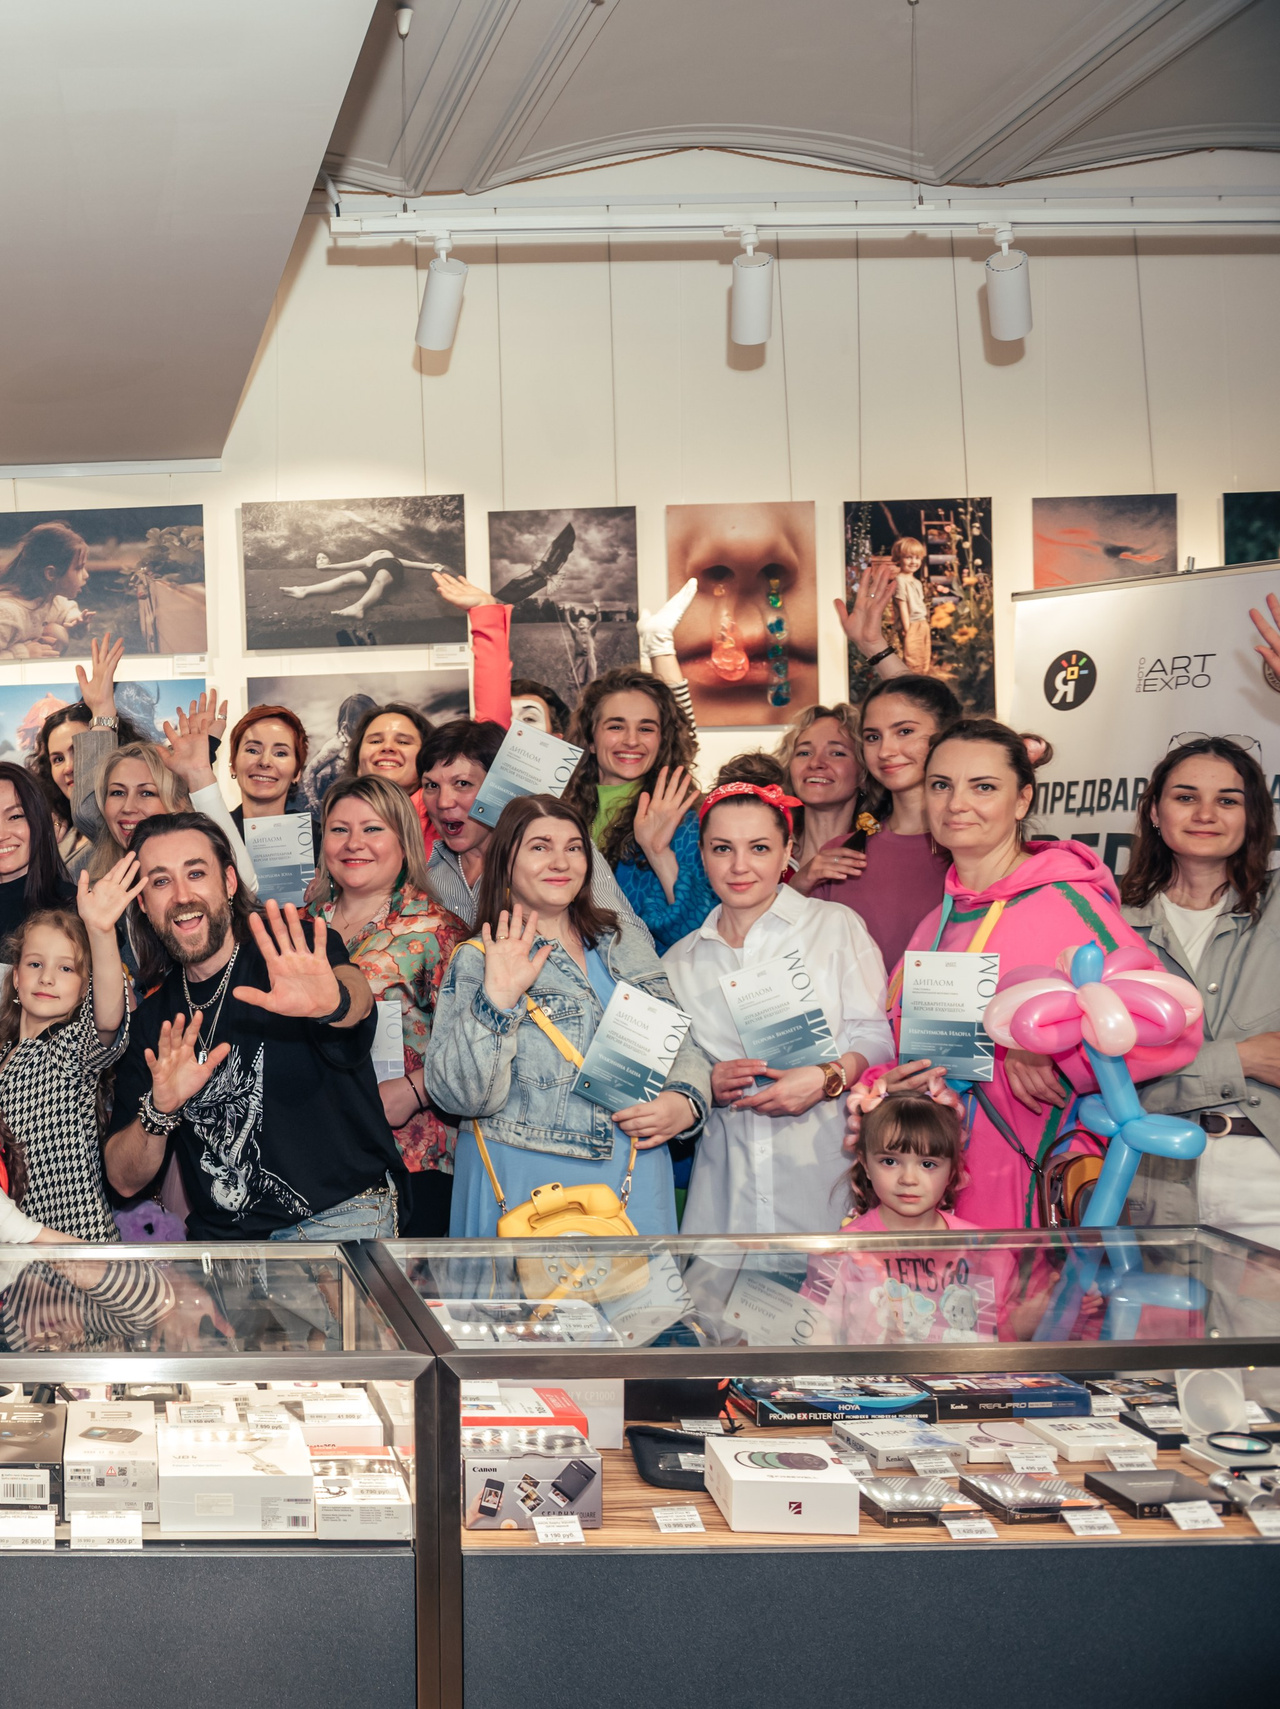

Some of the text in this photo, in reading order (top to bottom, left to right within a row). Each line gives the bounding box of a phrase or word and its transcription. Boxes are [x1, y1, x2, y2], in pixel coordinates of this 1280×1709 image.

[1145, 653, 1217, 677] ART
[1135, 657, 1146, 693] PHOTO
[1143, 674, 1211, 692] EXPO
[509, 745, 541, 763] ДИПЛОМ
[252, 836, 282, 844] ДИПЛОМ
[913, 979, 954, 987] ДИПЛОМ
[737, 986, 773, 1004] ДИПЛОМ
[616, 1010, 649, 1031] ДИПЛОМ
[585, 1391, 616, 1400] CP1000
